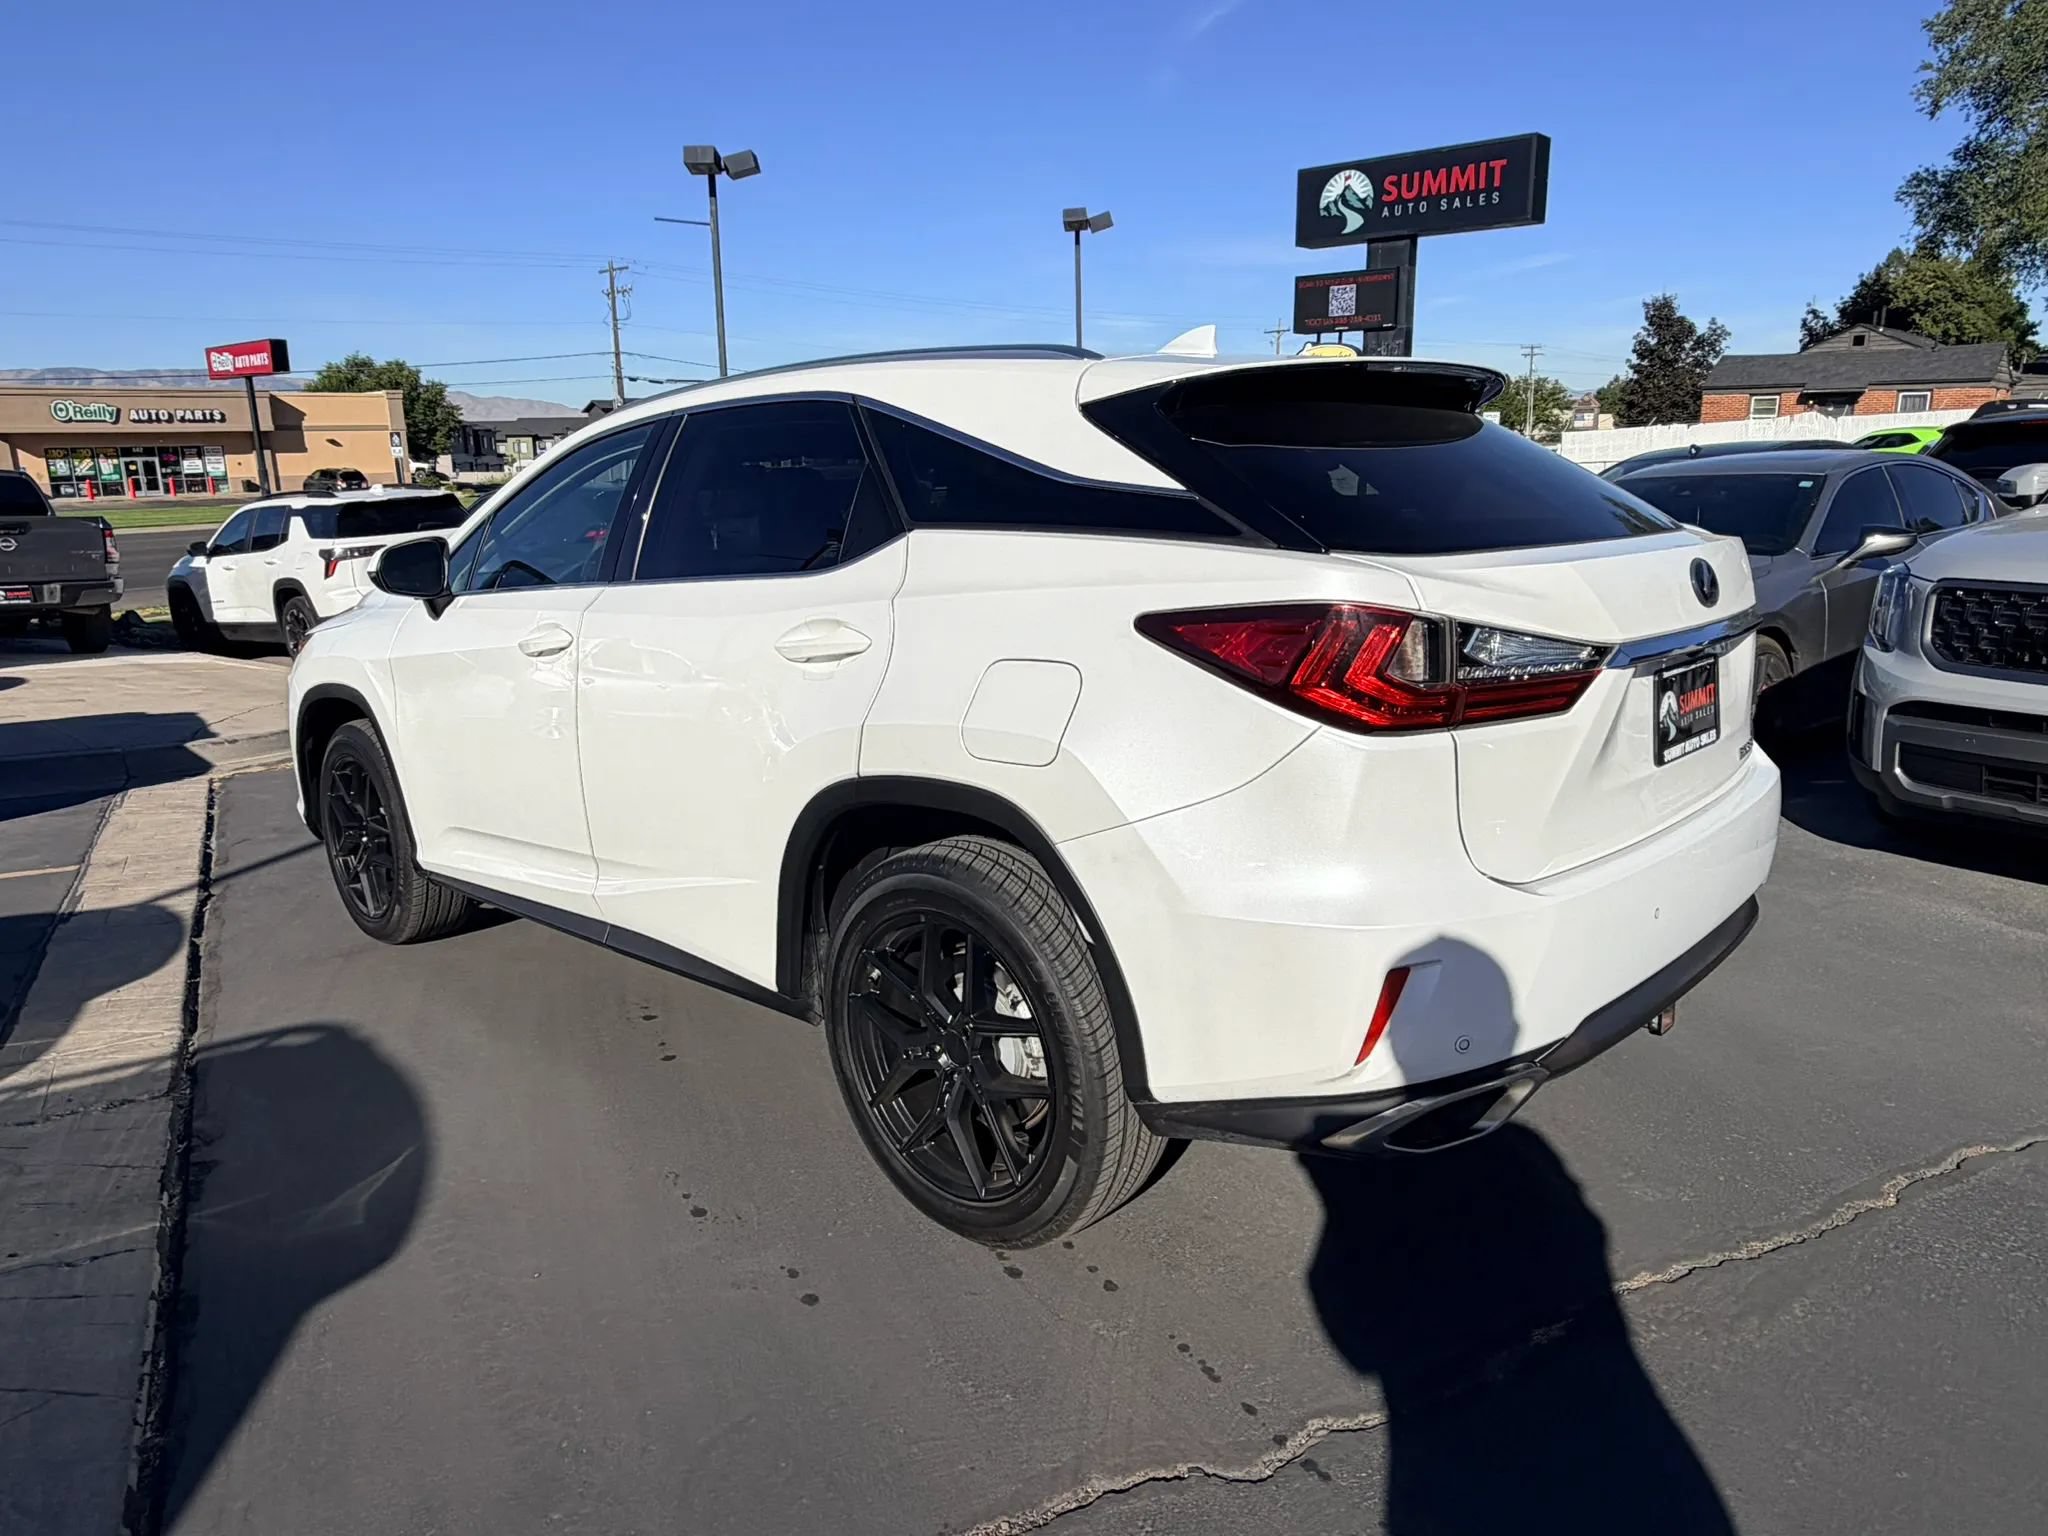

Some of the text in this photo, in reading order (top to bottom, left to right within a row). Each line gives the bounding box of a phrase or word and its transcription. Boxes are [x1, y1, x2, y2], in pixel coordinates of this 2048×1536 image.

[1381, 159, 1508, 202] SUMMIT
[1381, 192, 1501, 218] AUTO SALES
[250, 352, 269, 366] PARTS
[51, 400, 222, 422] O'Reilly AUTO PARTS
[1679, 683, 1715, 715] SUMMIT
